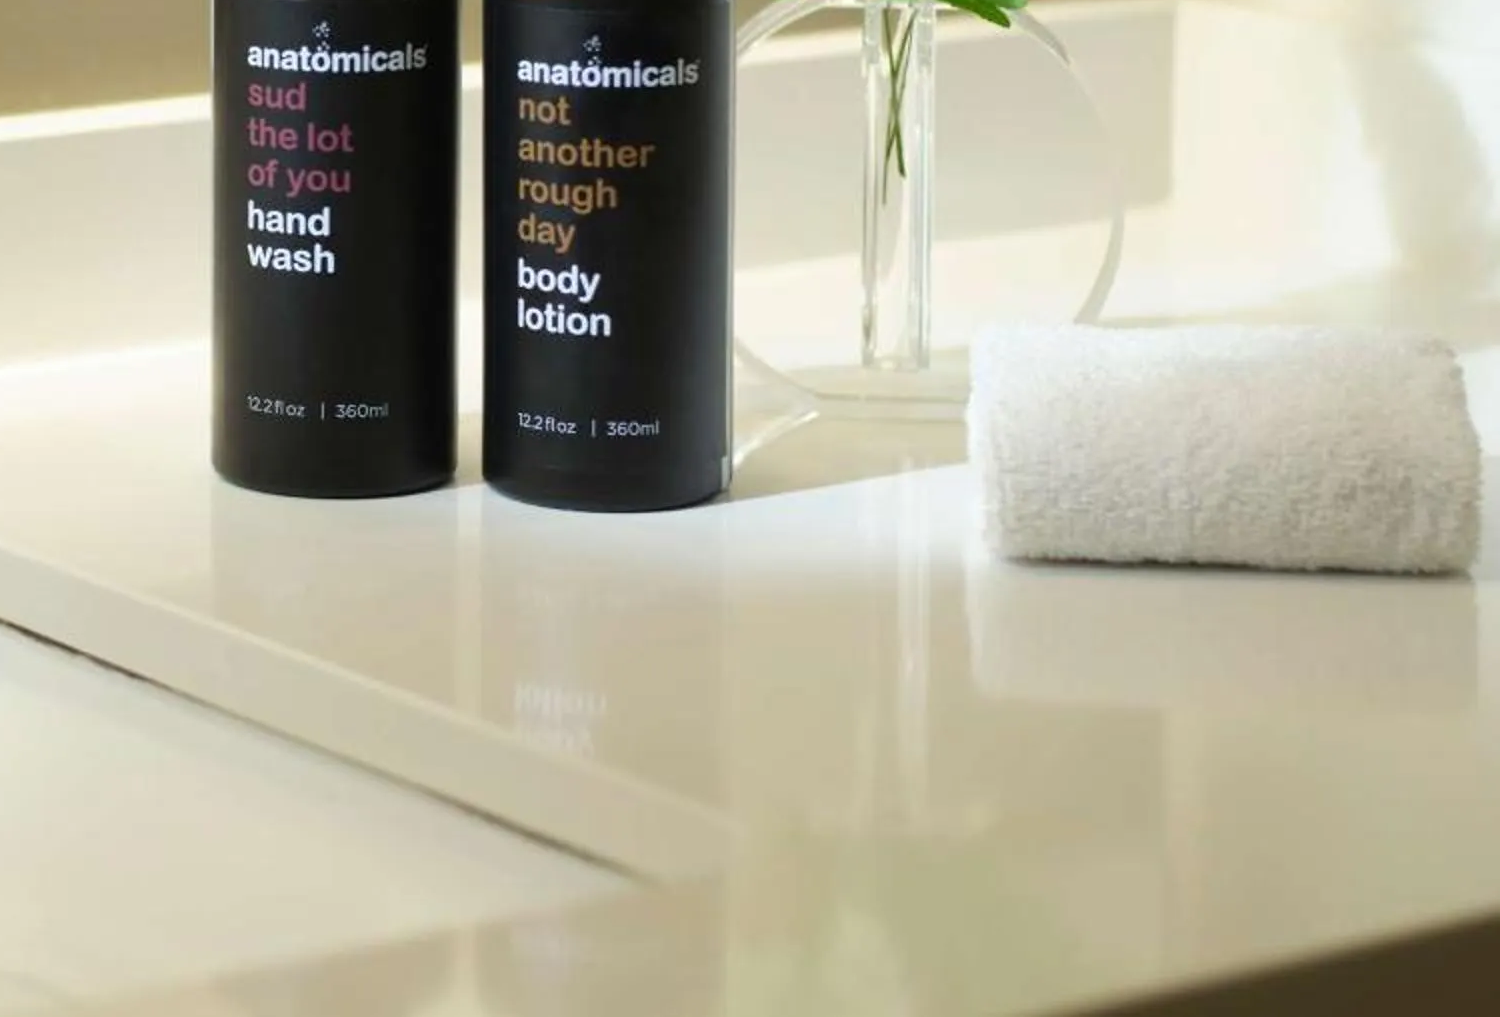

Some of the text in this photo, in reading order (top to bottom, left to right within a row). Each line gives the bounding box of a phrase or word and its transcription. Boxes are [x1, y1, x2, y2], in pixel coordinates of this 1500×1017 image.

[247, 42, 426, 73] anatomicals
[517, 57, 699, 87] anatomicals
[248, 83, 306, 110] sud
[519, 96, 571, 125] not
[247, 118, 354, 153] the lot
[518, 138, 655, 168] another
[248, 159, 351, 198] of you
[519, 178, 618, 214] rough
[247, 199, 331, 237] hand
[518, 215, 576, 253] day
[247, 243, 335, 274] wash
[518, 258, 600, 303] body
[518, 298, 611, 336] lotion
[335, 403, 389, 419] 360ml
[607, 419, 660, 436] 360ml
